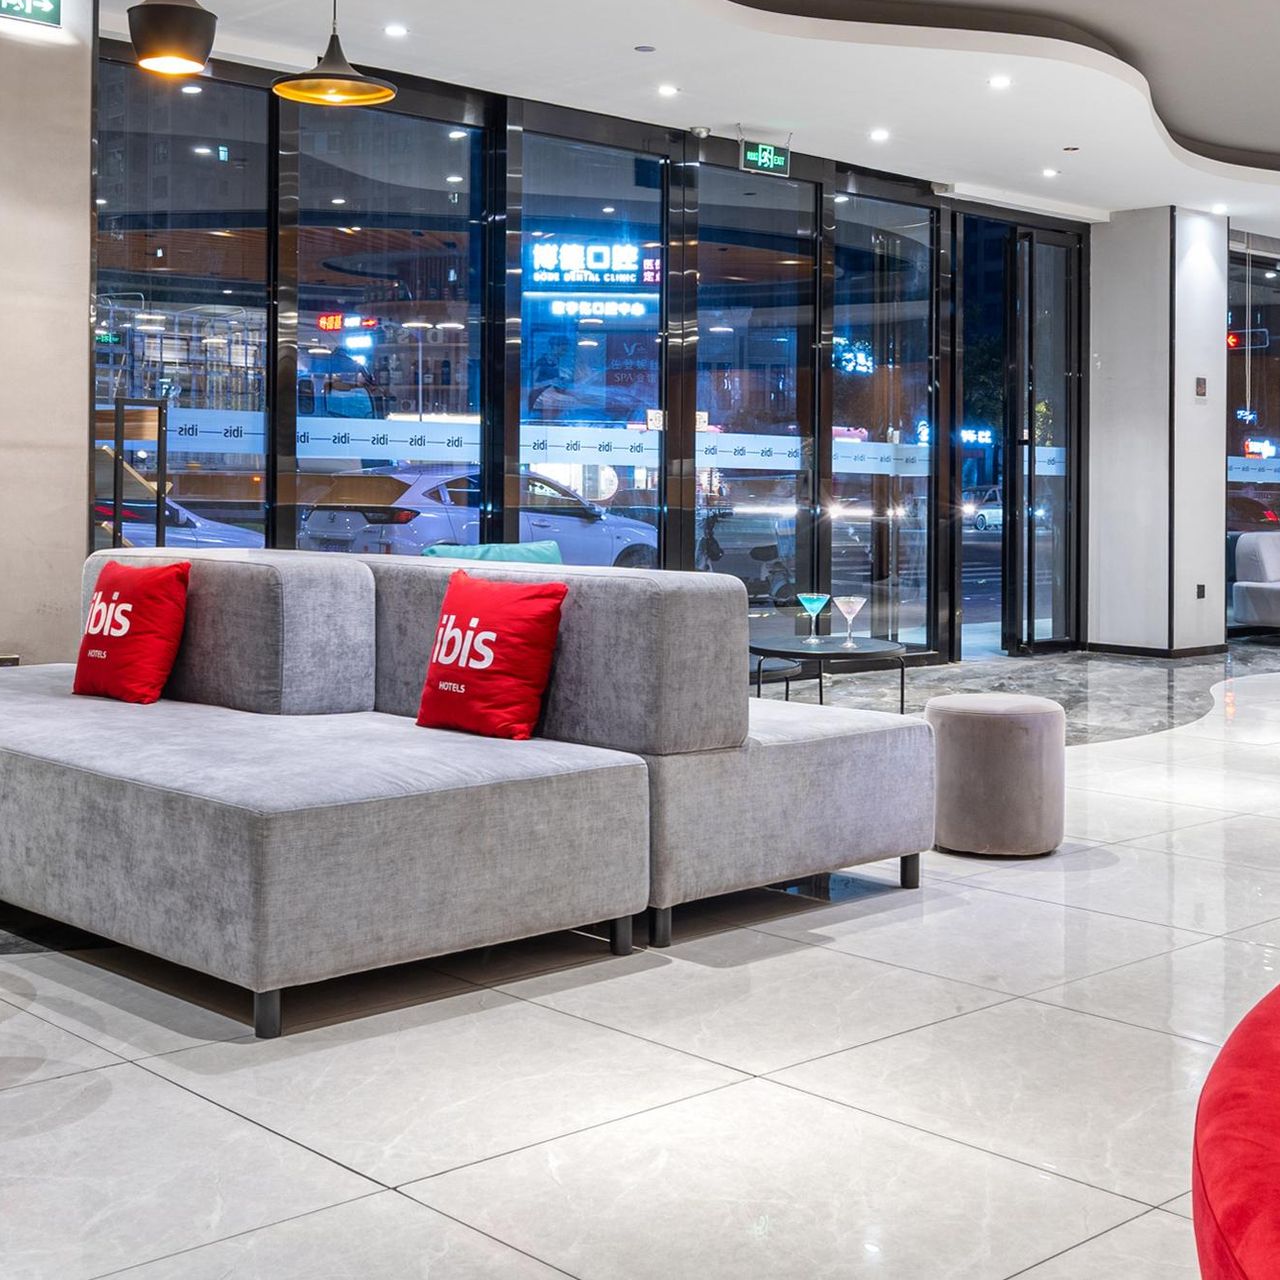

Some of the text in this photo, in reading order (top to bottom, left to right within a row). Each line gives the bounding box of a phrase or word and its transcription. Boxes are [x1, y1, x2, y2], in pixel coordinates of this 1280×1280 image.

[563, 271, 601, 282] DENTAL
[603, 272, 637, 283] CLINIC
[84, 591, 133, 637] ibis
[432, 614, 497, 670] ibis
[87, 649, 107, 659] HOTELS
[438, 681, 466, 694] HOTELS
